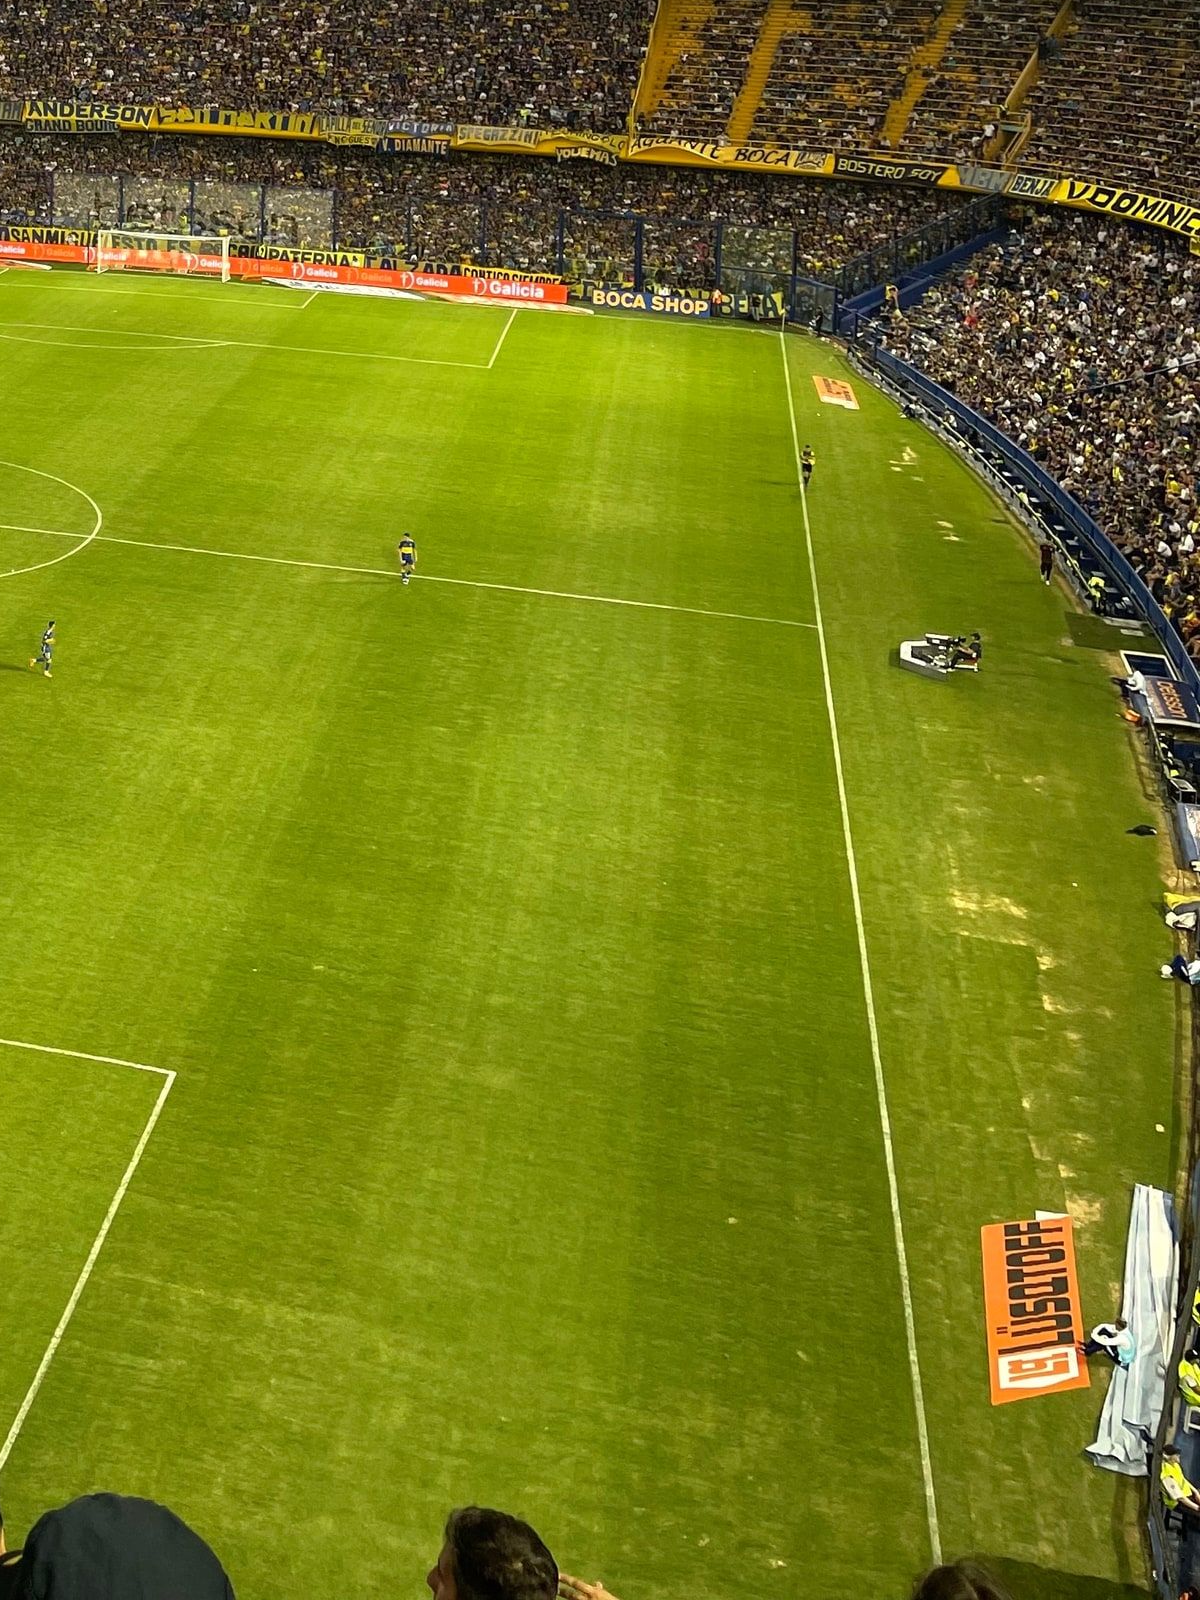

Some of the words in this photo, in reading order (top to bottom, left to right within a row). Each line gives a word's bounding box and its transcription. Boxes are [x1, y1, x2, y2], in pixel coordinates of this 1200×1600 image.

[28, 101, 155, 126] ANDERSON
[27, 120, 74, 133] GRAND
[395, 139, 448, 155] DIAMANTE
[735, 148, 790, 166] BOCA
[838, 159, 905, 180] BOSTERO
[907, 169, 942, 182] SOY
[306, 267, 338, 279] Galicia
[416, 276, 448, 288] Galicia
[490, 281, 544, 299] Galicia
[593, 289, 646, 310] BOCA
[651, 296, 708, 315] SHOP
[996, 1221, 1076, 1355] LÜSQTOFF
